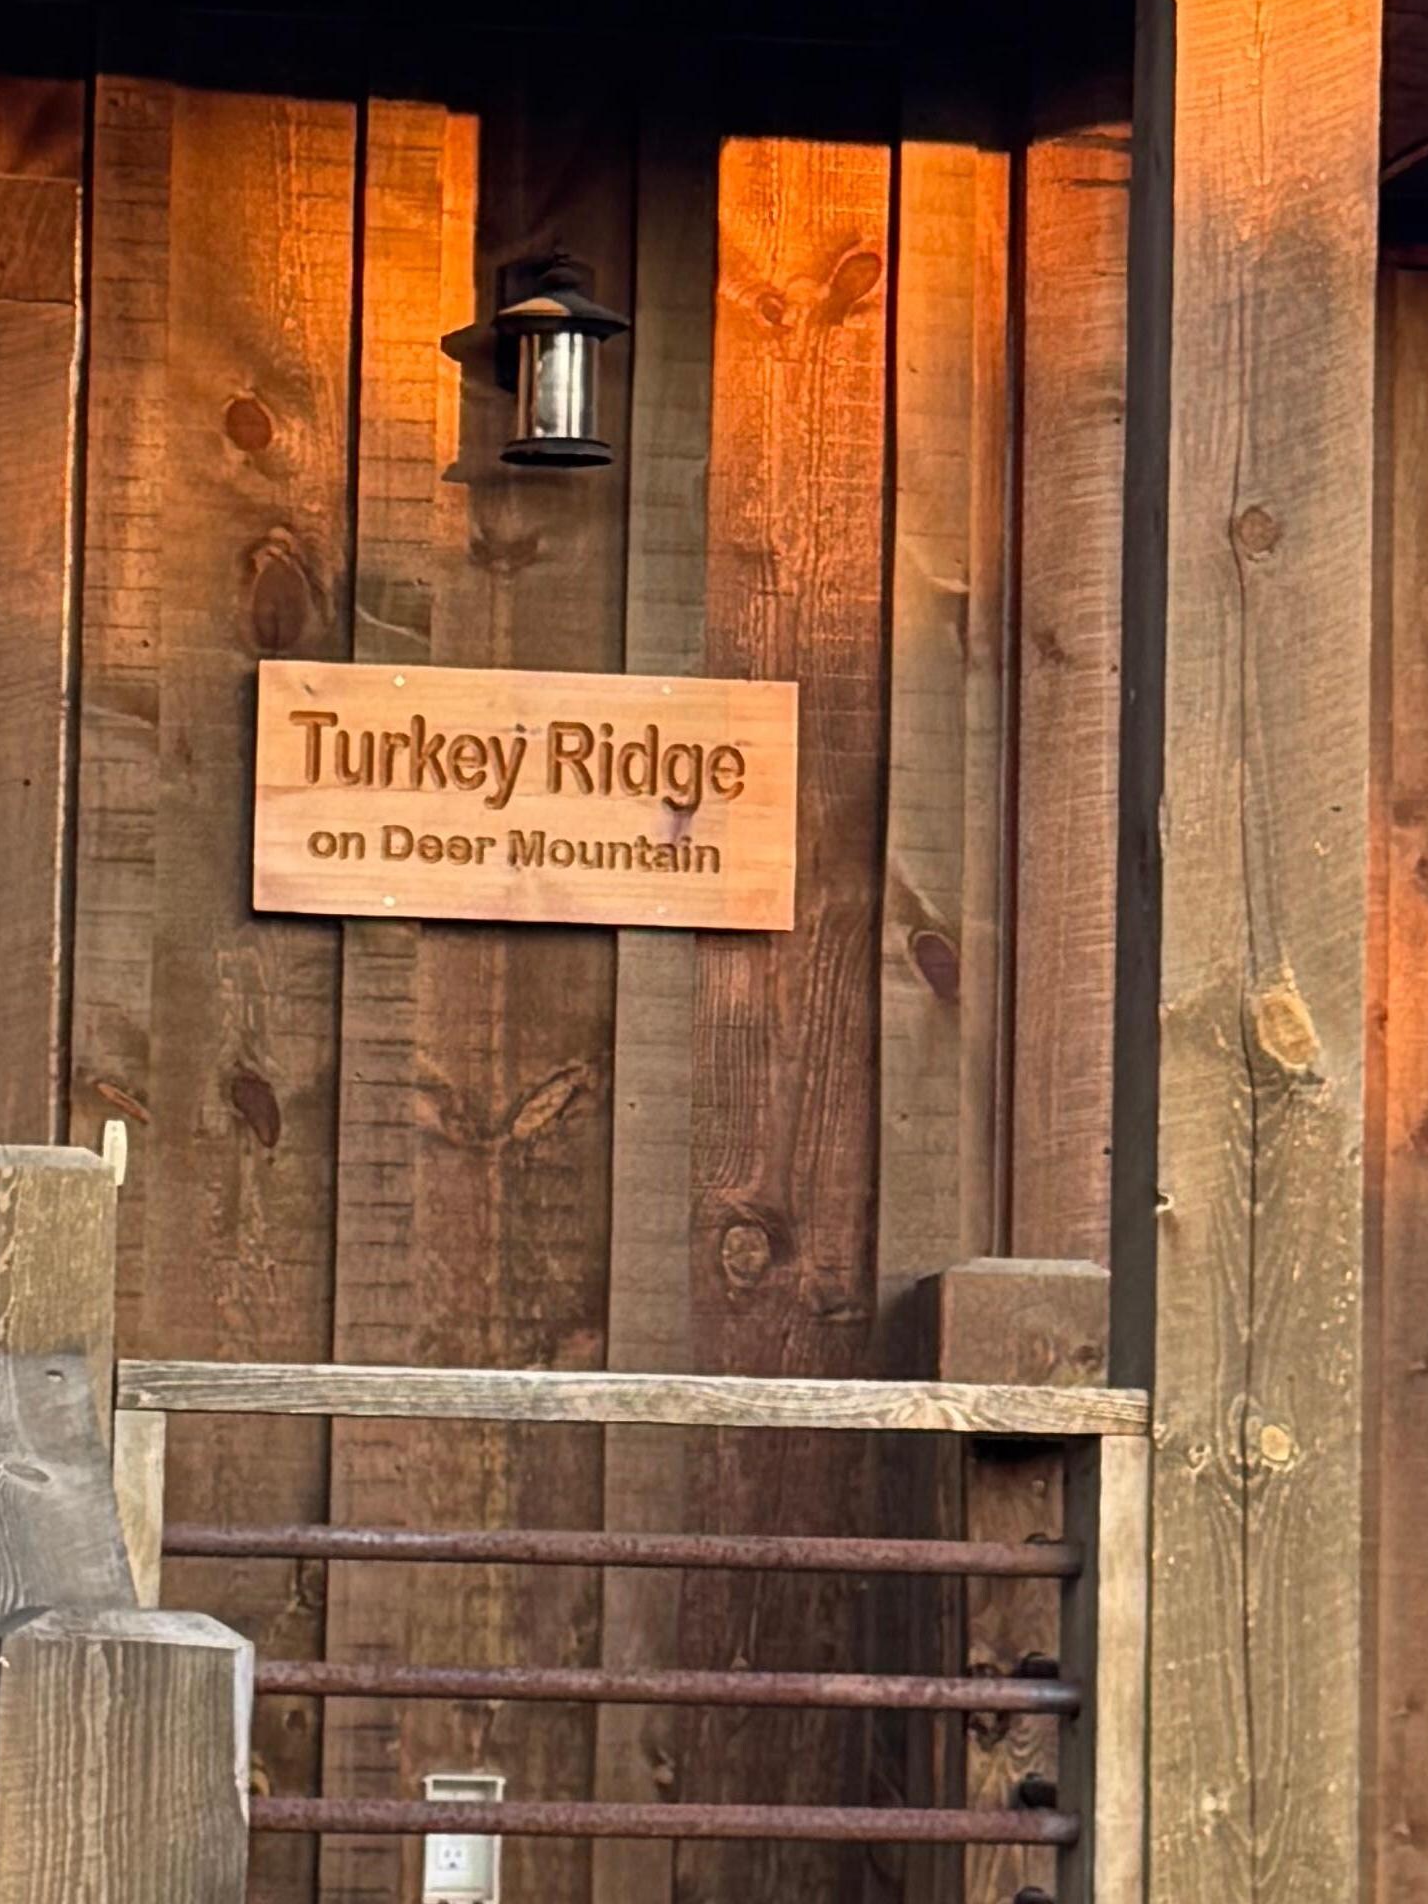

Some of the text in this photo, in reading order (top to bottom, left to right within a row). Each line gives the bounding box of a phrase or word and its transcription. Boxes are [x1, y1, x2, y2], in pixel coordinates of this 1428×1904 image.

[288, 710, 746, 812] Turkey Ridge
[307, 824, 721, 873] on Deer Mountain
